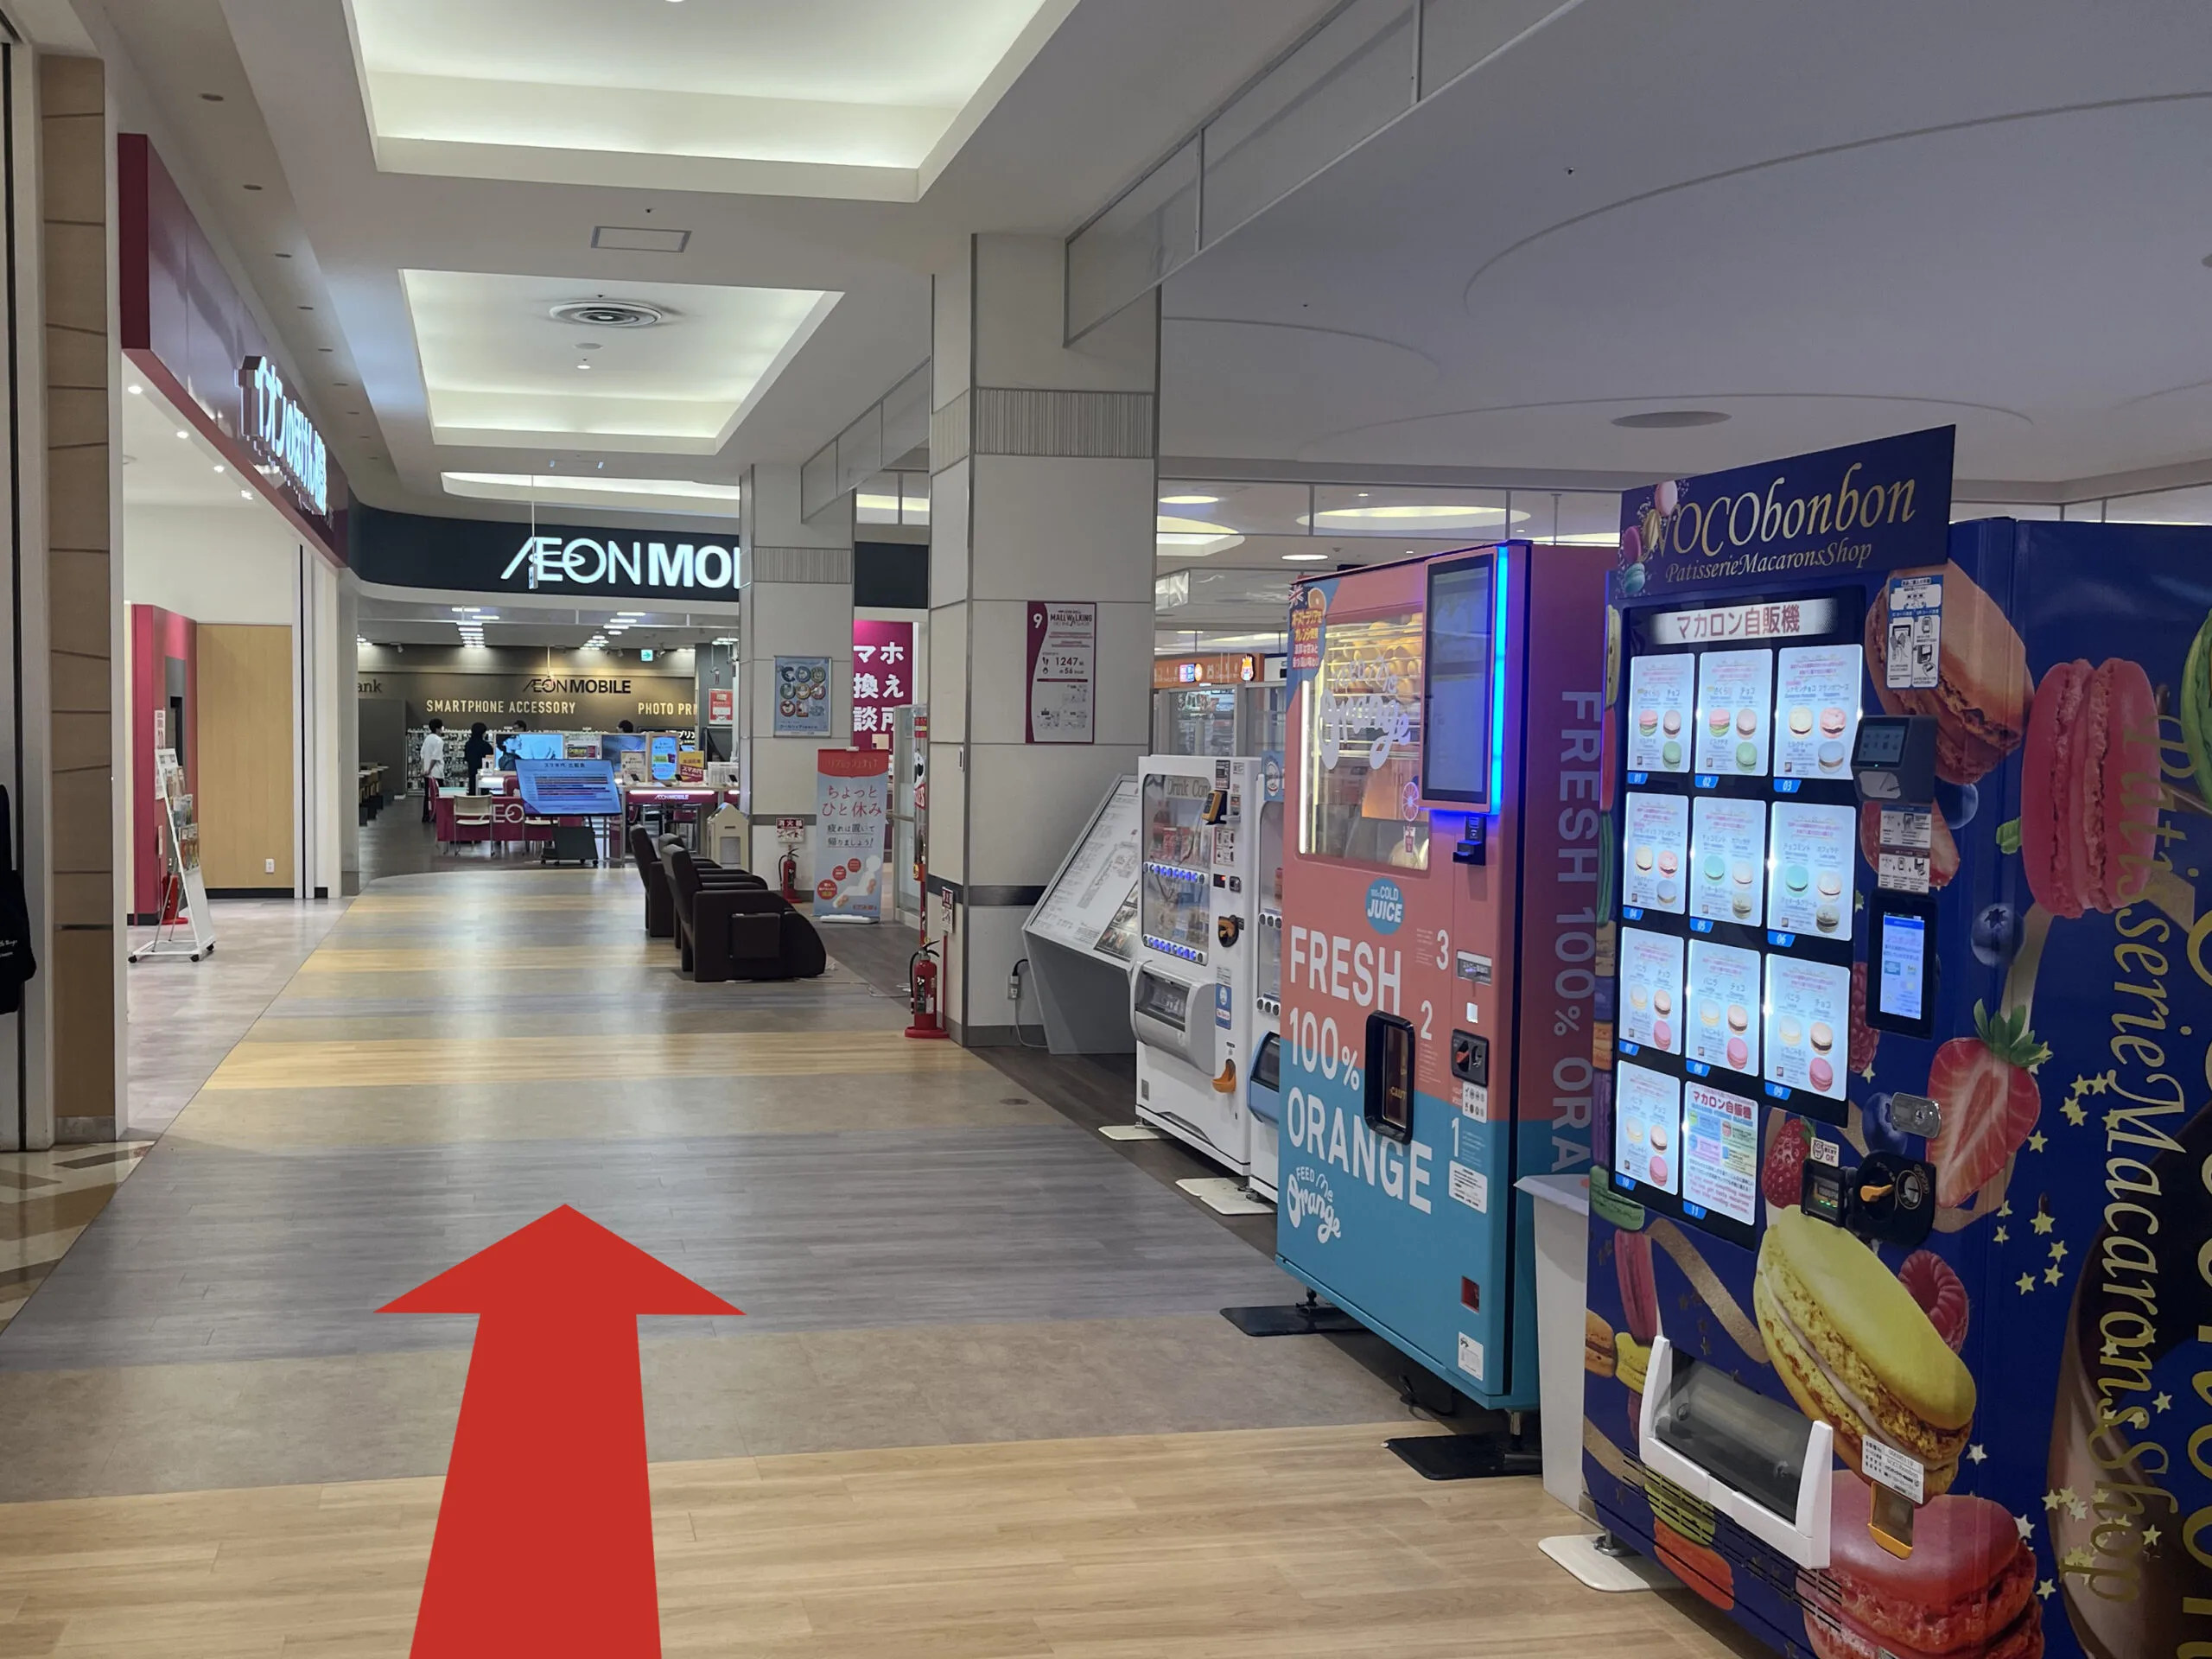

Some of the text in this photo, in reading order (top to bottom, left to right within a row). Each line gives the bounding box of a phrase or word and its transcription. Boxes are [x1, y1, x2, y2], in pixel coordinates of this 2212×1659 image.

[648, 543, 741, 588] MO
[1033, 613, 1043, 628] 9
[1677, 604, 1801, 639] マカロン自販機
[1055, 657, 1079, 666] 1247
[570, 679, 632, 694] MOBILE
[426, 699, 576, 715] SMARTPHONE ACCESSORY
[638, 702, 674, 715] PHOTO
[1557, 691, 1601, 883] FRESH
[1702, 778, 1712, 787] 02
[1782, 780, 1792, 791] 03
[828, 785, 878, 799] ちょっと
[822, 801, 882, 817] ひと休み
[1380, 886, 1399, 901] COLD
[1367, 899, 1403, 923] JUICE
[1777, 934, 1786, 944] 06
[1436, 929, 1449, 970] 3
[1290, 925, 1402, 1015] FRESH
[1554, 906, 1596, 1035] 100%
[1421, 1000, 1433, 1040] 2
[1289, 1007, 1361, 1091] 100%
[1773, 1085, 1783, 1097] 09
[1693, 1090, 1752, 1120] マカロン自販機
[1452, 1117, 1459, 1157] 1
[1287, 1087, 1433, 1215] ORANGE
[1825, 1154, 1834, 1163] OK
[1296, 1166, 1315, 1183] FEED
[1287, 1173, 1342, 1243] Orange
[1691, 1205, 1699, 1217] 11
